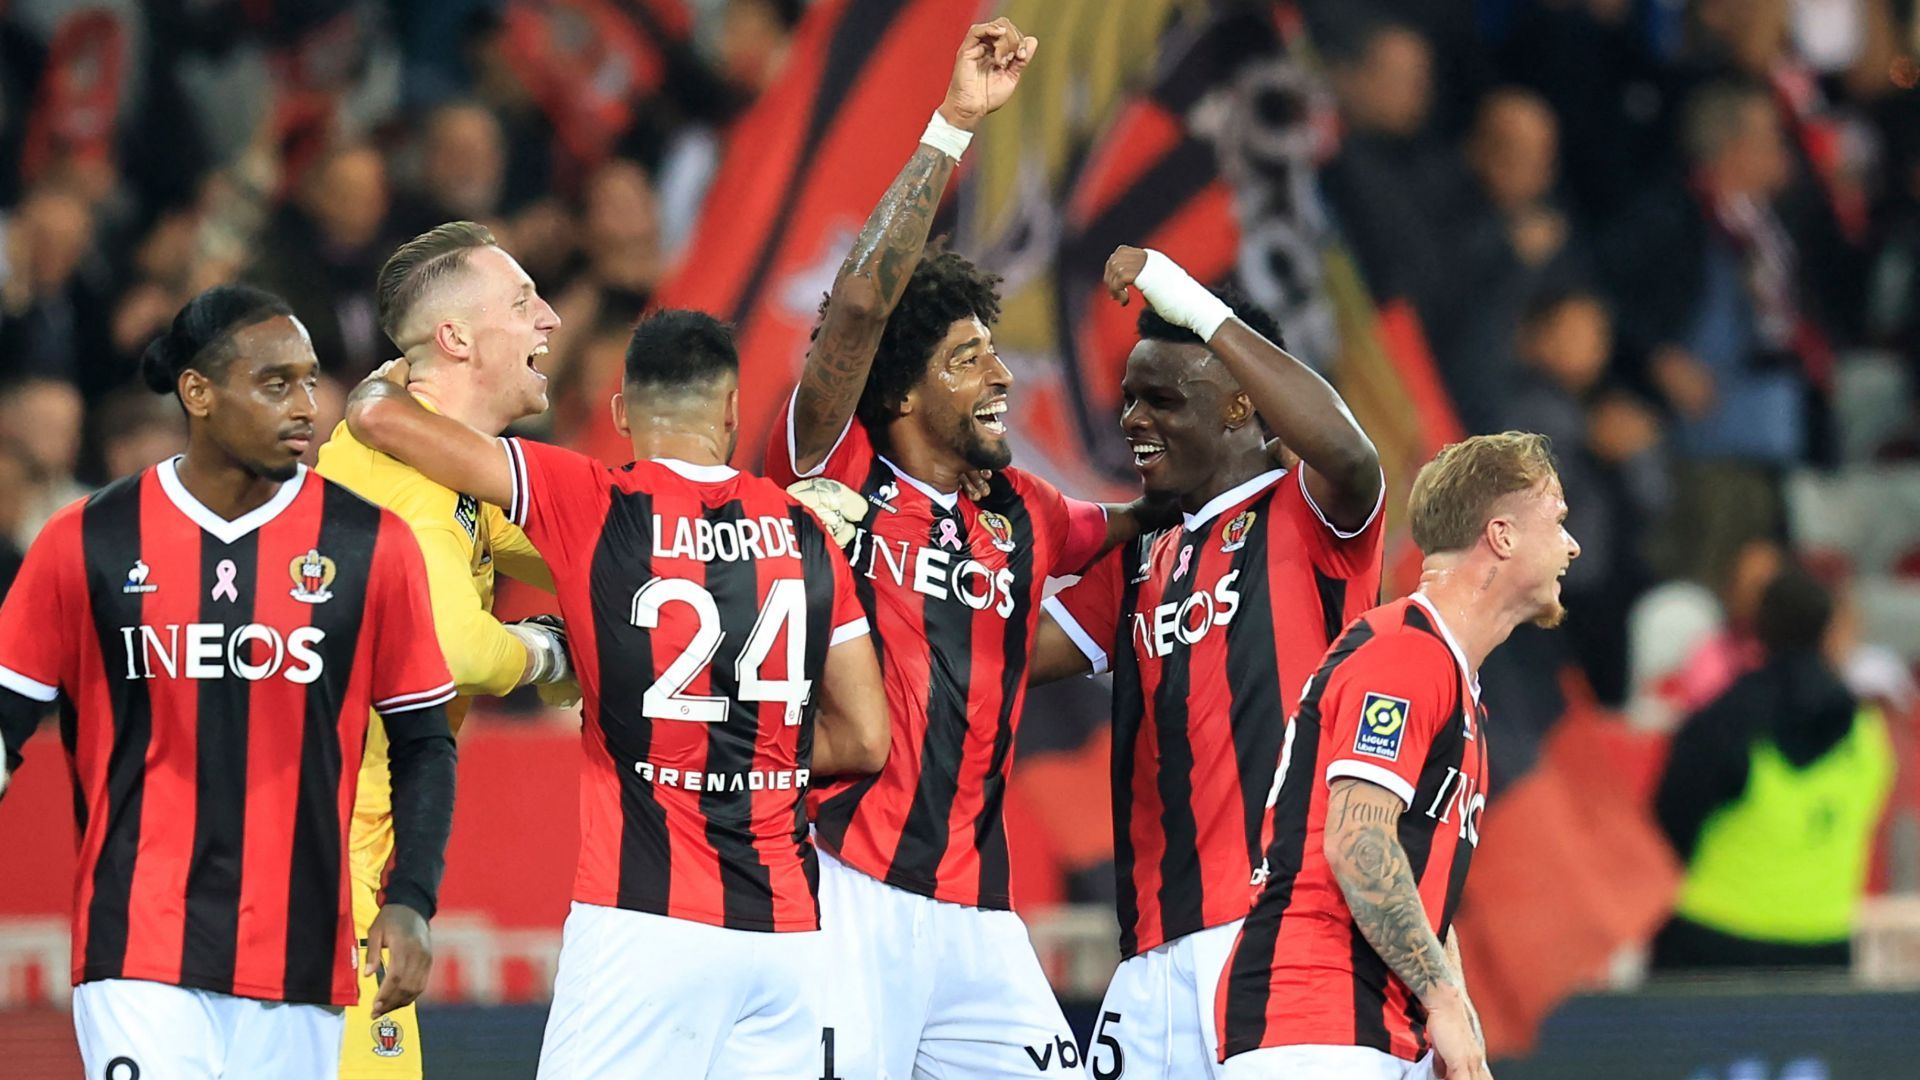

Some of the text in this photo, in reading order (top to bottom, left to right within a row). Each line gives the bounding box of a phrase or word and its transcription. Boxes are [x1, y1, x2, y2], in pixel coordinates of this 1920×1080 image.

[651, 513, 802, 562] LABORDE
[1133, 568, 1241, 659] NEOS
[120, 622, 326, 684] INEOS
[630, 575, 813, 726] 24
[634, 761, 810, 792] GRENADIER
[1092, 1011, 1125, 1080] 5
